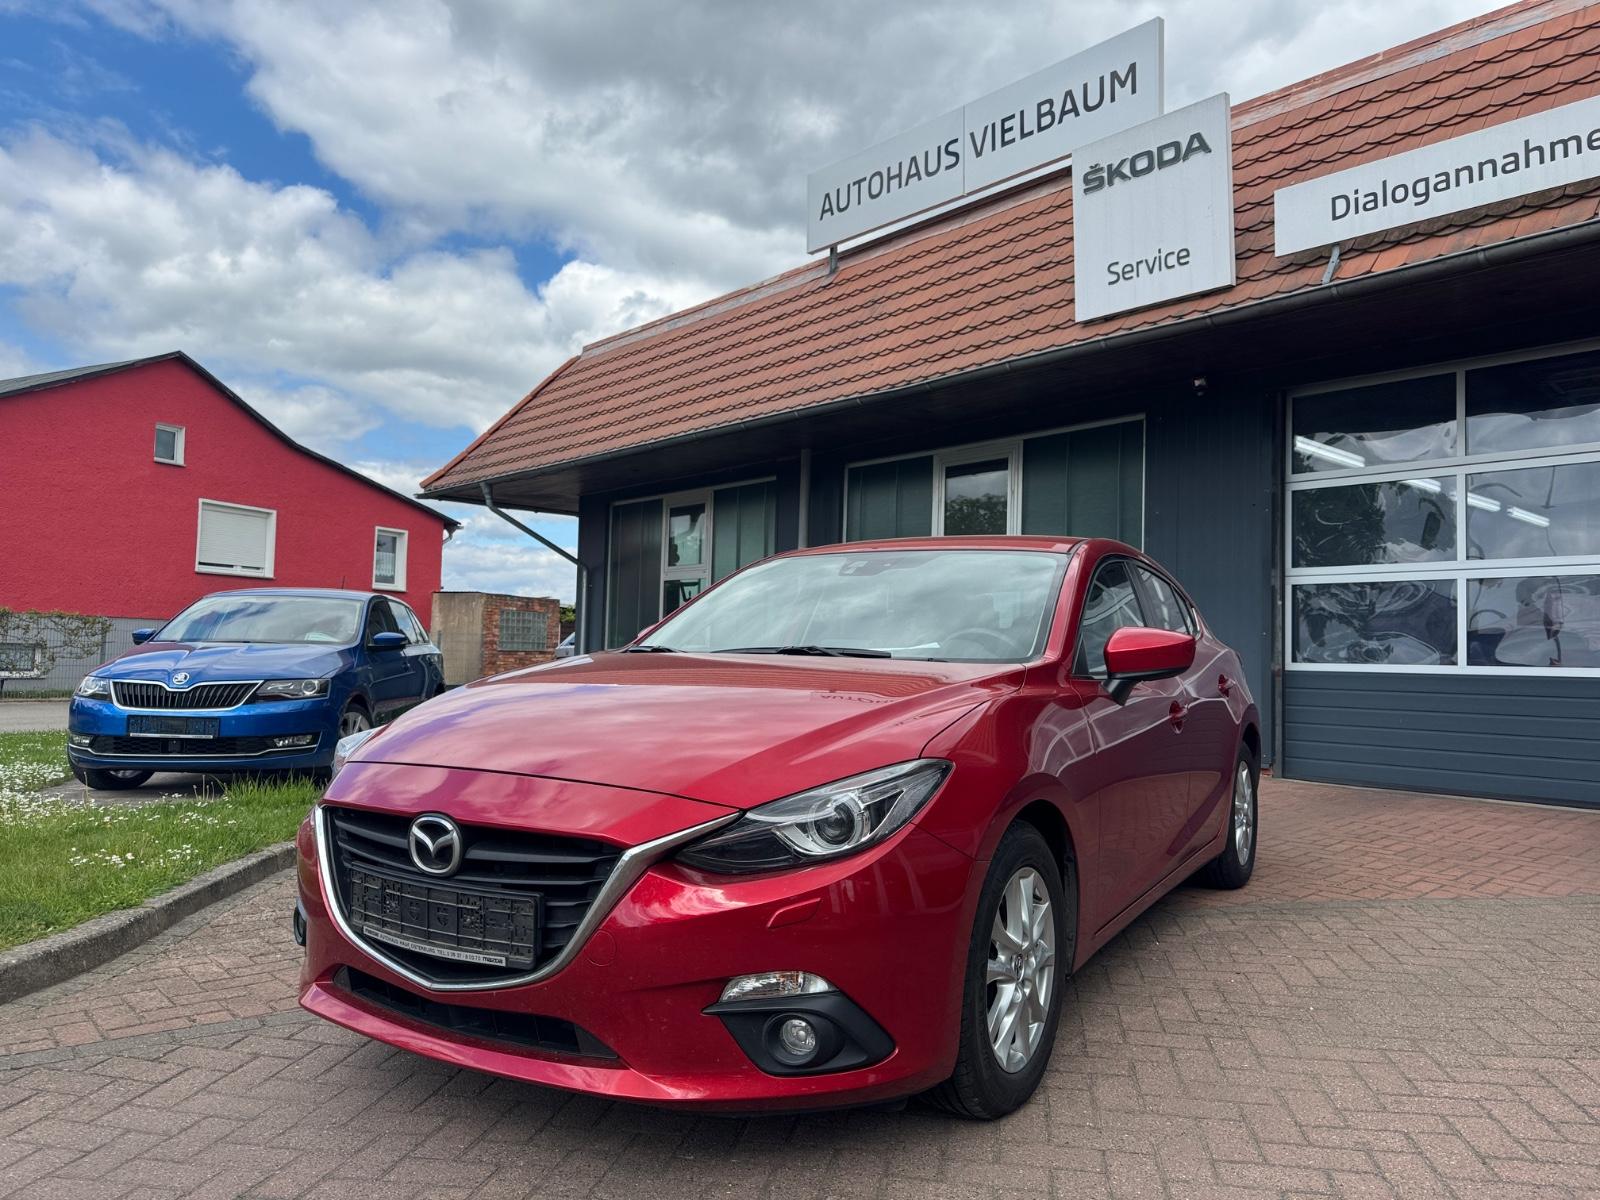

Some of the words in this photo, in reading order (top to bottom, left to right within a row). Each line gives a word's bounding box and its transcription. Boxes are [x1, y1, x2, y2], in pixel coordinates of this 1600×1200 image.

[819, 138, 960, 221] AUTOHAUS
[969, 62, 1137, 159] VIELBAUM
[1083, 131, 1212, 195] ŠKODA
[1330, 127, 1600, 221] Dialogannahme
[1107, 247, 1190, 285] Service
